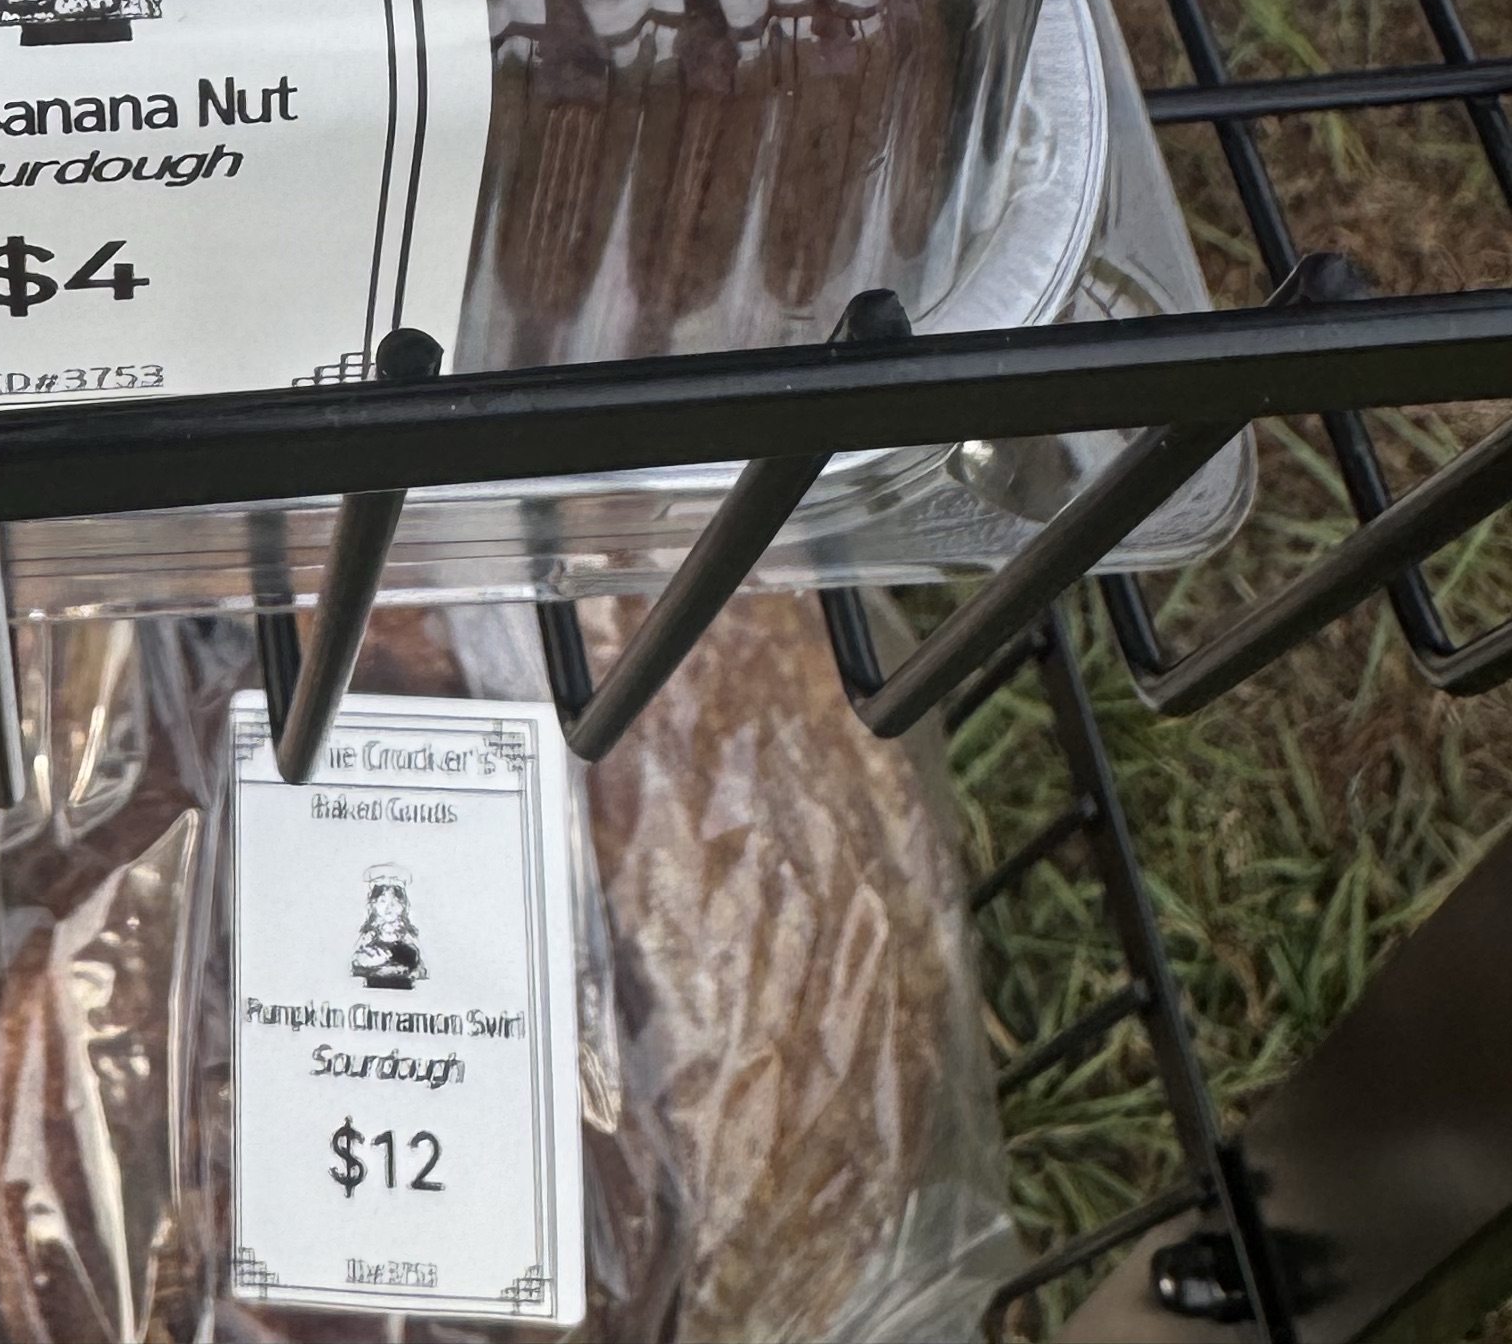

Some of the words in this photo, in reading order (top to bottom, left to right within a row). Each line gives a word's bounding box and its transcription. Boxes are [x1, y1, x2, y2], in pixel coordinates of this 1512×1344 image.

[198, 76, 299, 128] Nut
[246, 997, 345, 1032] Pumpkin
[348, 1002, 464, 1036] Cinnamon
[466, 1008, 526, 1040] Swirl
[309, 1043, 466, 1090] Sourdough
[328, 1115, 445, 1199] $12
